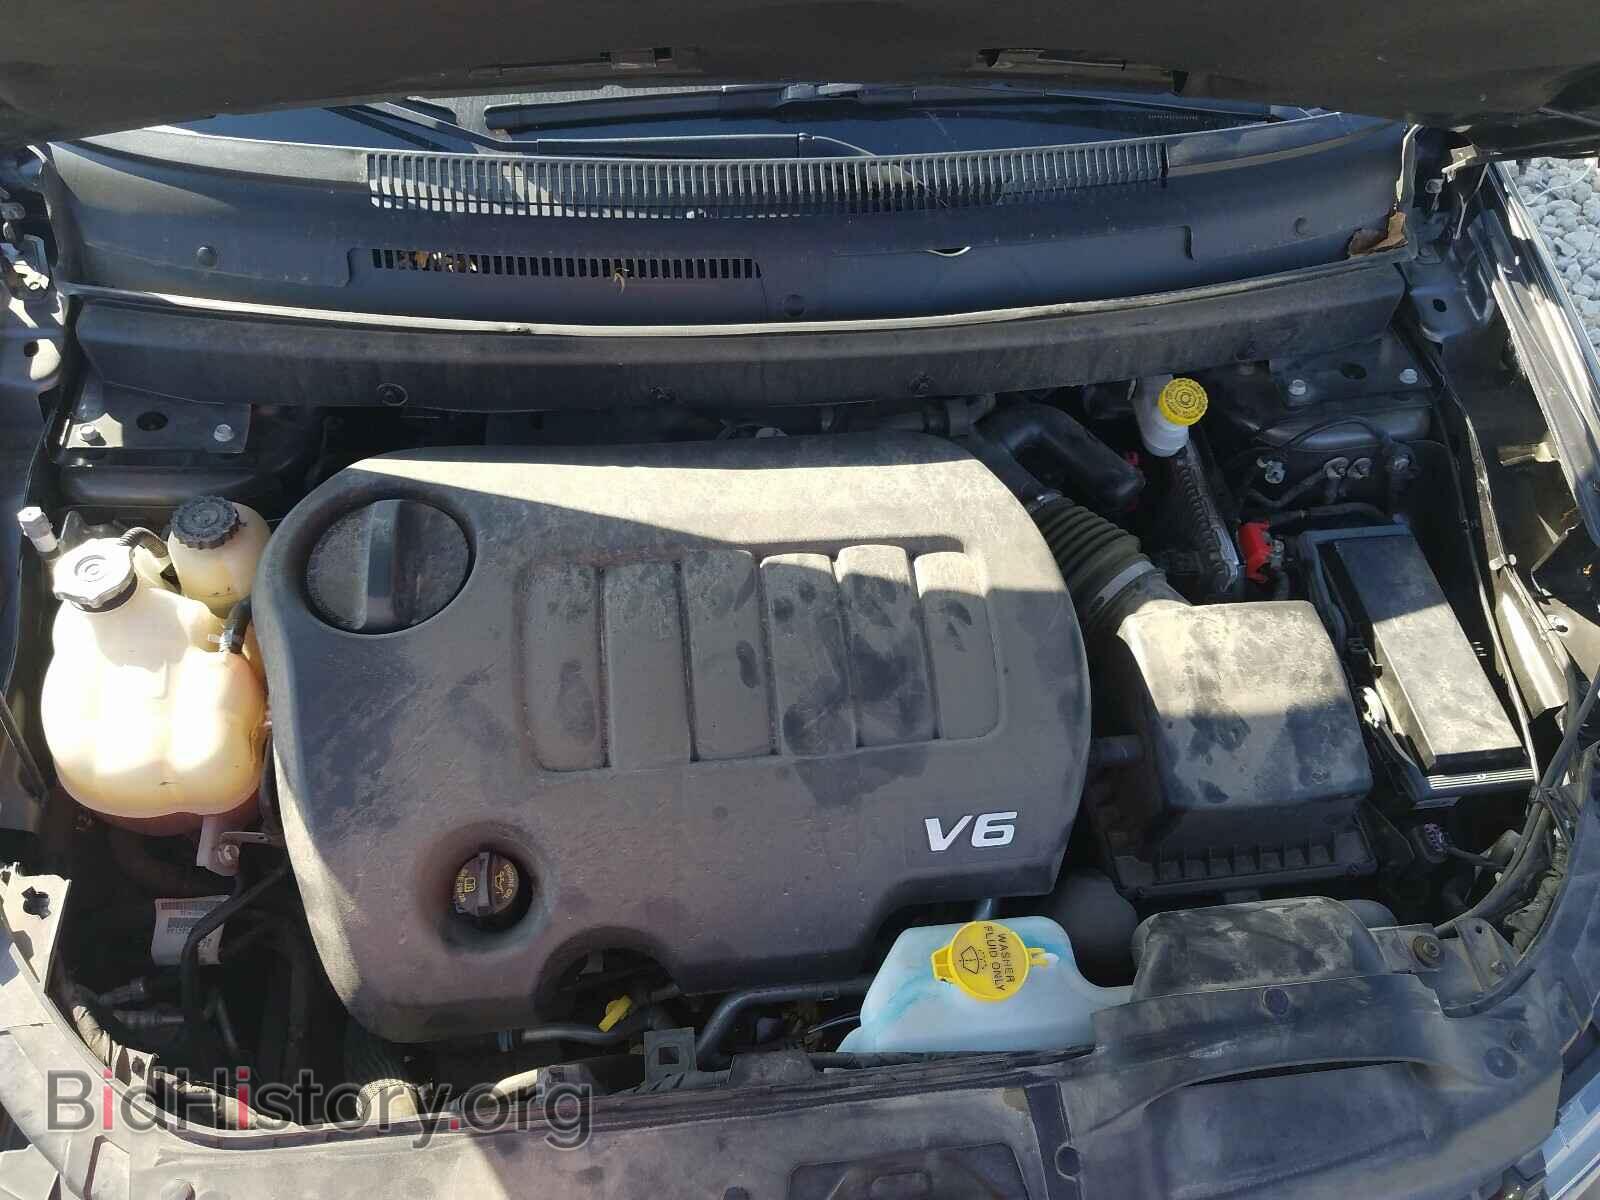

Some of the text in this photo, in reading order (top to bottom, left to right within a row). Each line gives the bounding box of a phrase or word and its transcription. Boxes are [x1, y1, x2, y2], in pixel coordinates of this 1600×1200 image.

[925, 811, 1018, 851] V6
[984, 925, 1006, 991] FLUID ONLY
[998, 934, 1016, 984] WASHER
